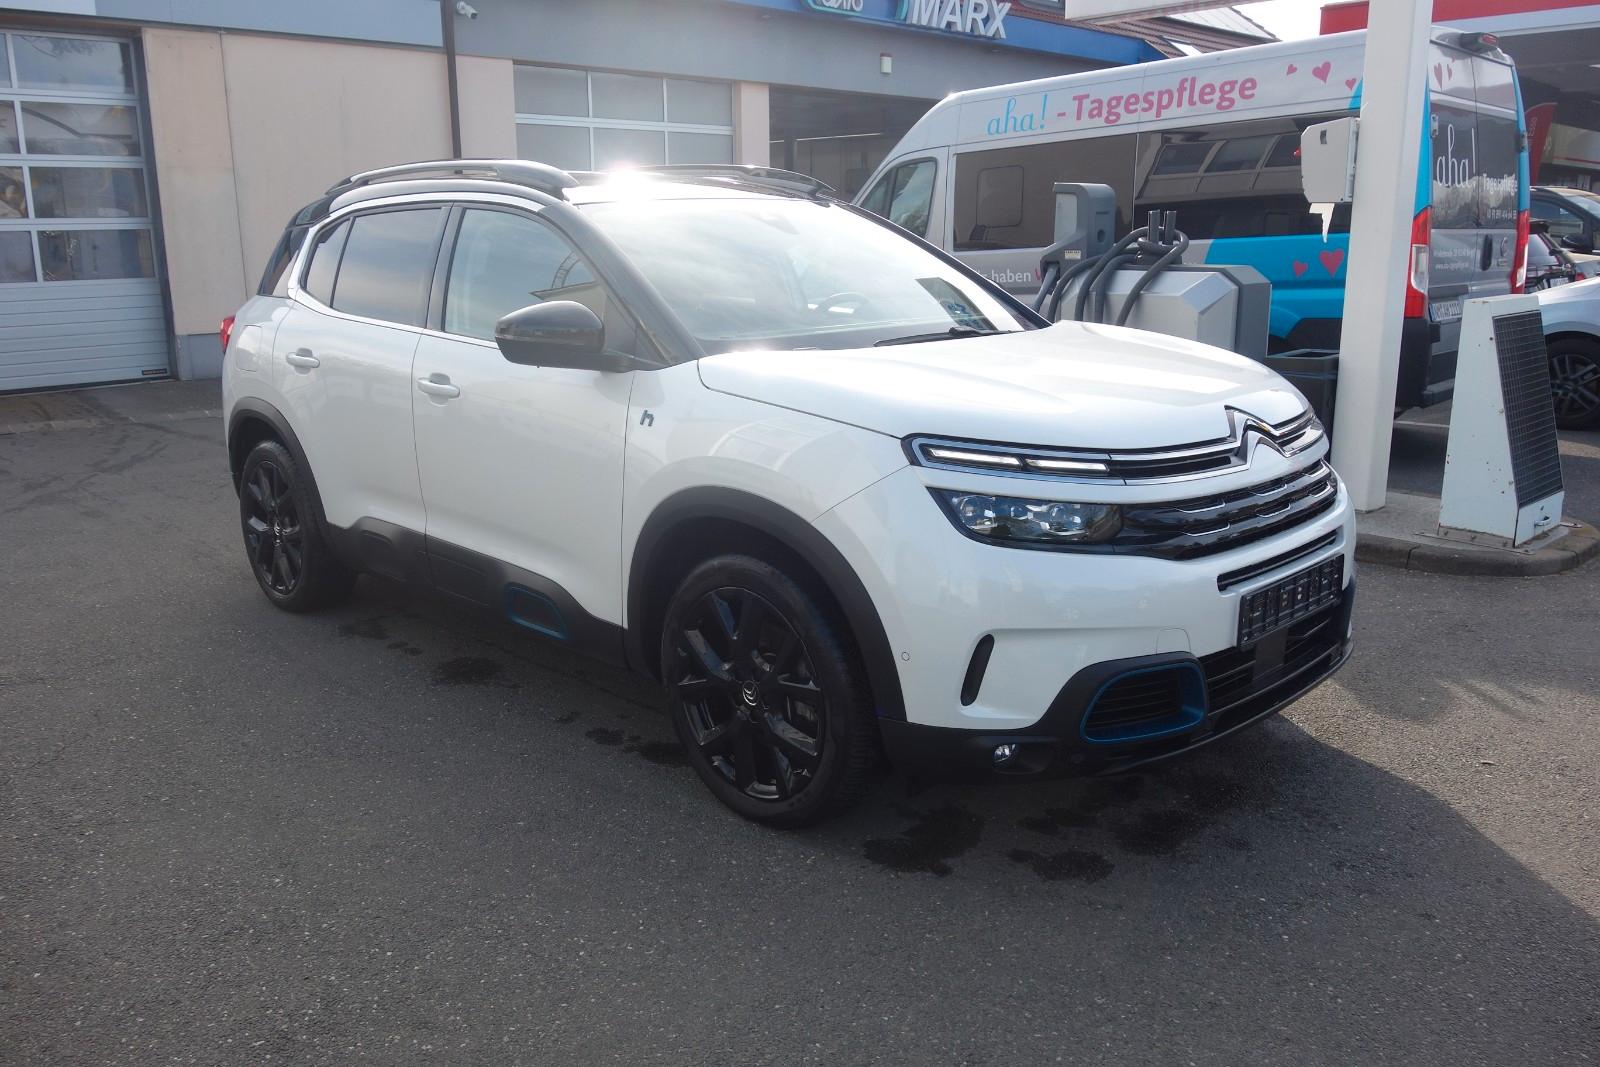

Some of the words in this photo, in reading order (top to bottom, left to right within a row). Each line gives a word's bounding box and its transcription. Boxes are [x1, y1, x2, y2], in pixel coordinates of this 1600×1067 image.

[908, 0, 1011, 39] MARX
[987, 93, 1047, 136] aha!
[1072, 76, 1258, 125] Tagespflege
[1437, 123, 1476, 188] aha!
[991, 268, 1031, 283] haben
